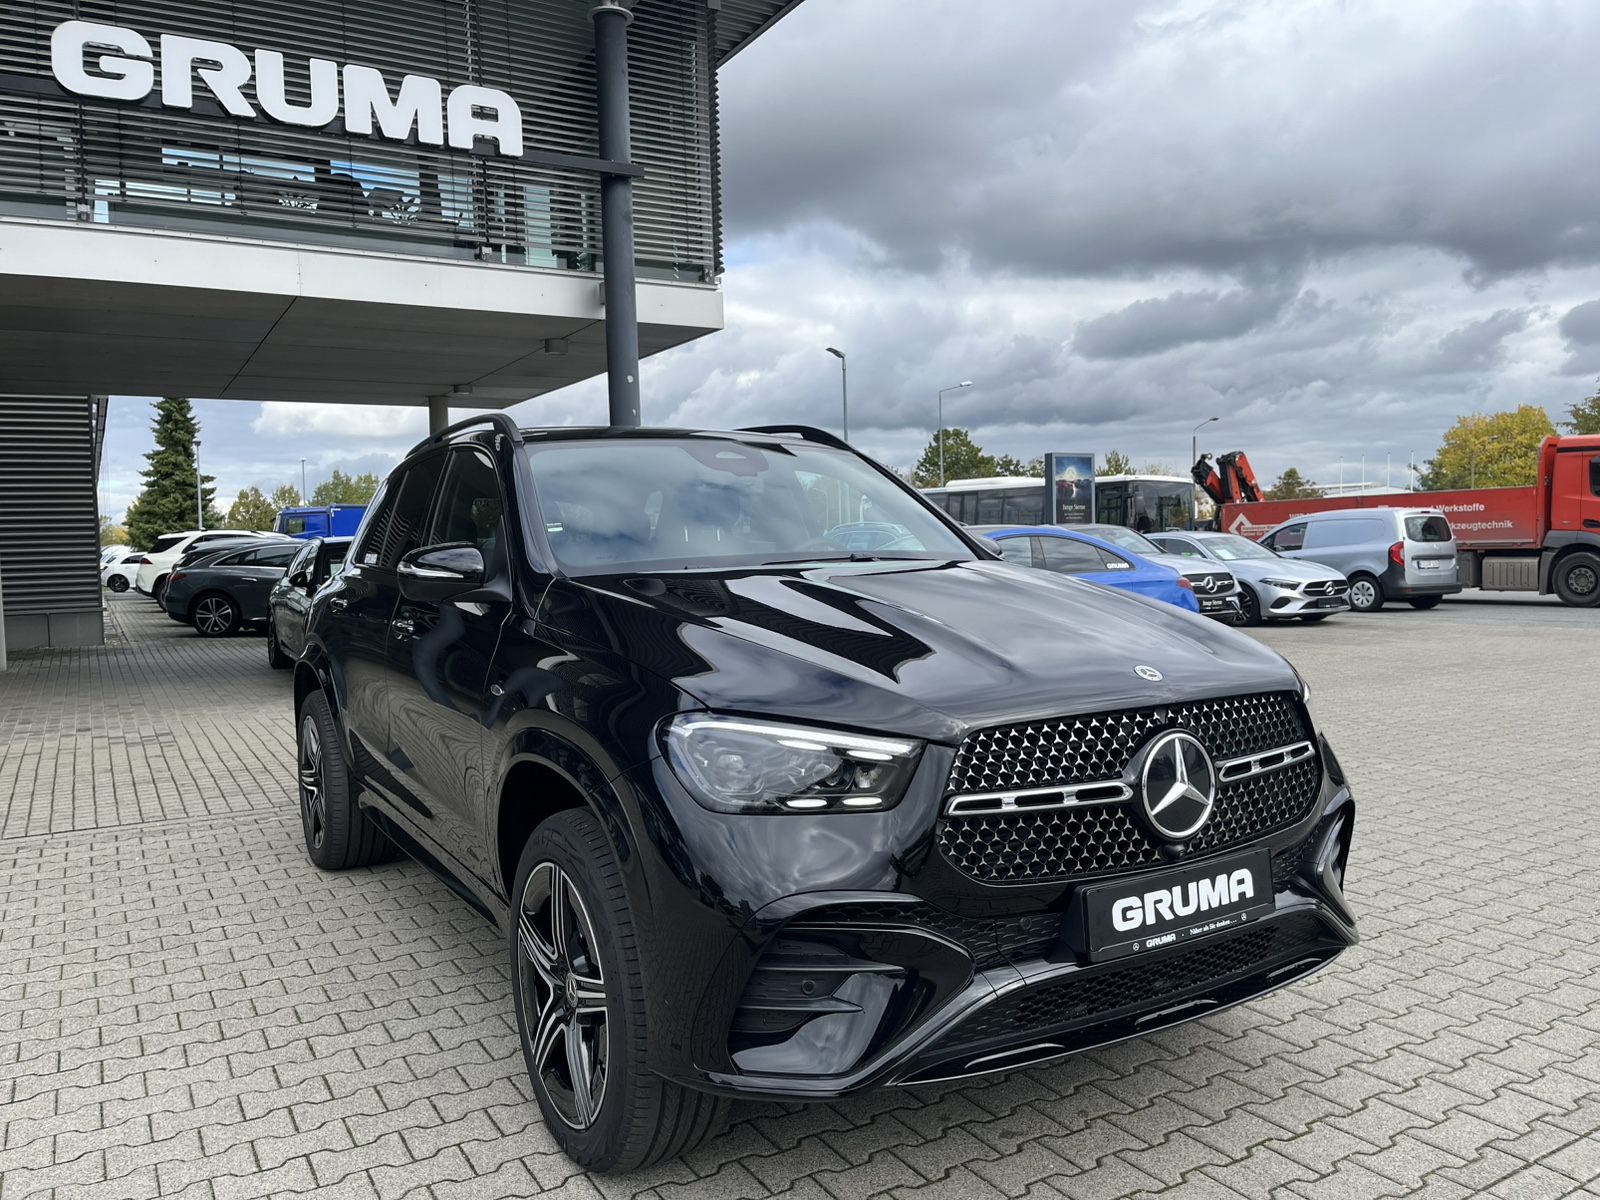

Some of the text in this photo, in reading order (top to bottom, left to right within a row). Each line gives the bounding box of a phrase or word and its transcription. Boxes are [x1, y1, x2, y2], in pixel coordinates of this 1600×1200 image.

[50, 20, 524, 157] GRUMA
[1436, 503, 1485, 512] Werkstoffe
[1450, 520, 1513, 531] kzeugtechnik
[1112, 868, 1254, 932] GRUMA
[1146, 933, 1176, 948] GRUMA
